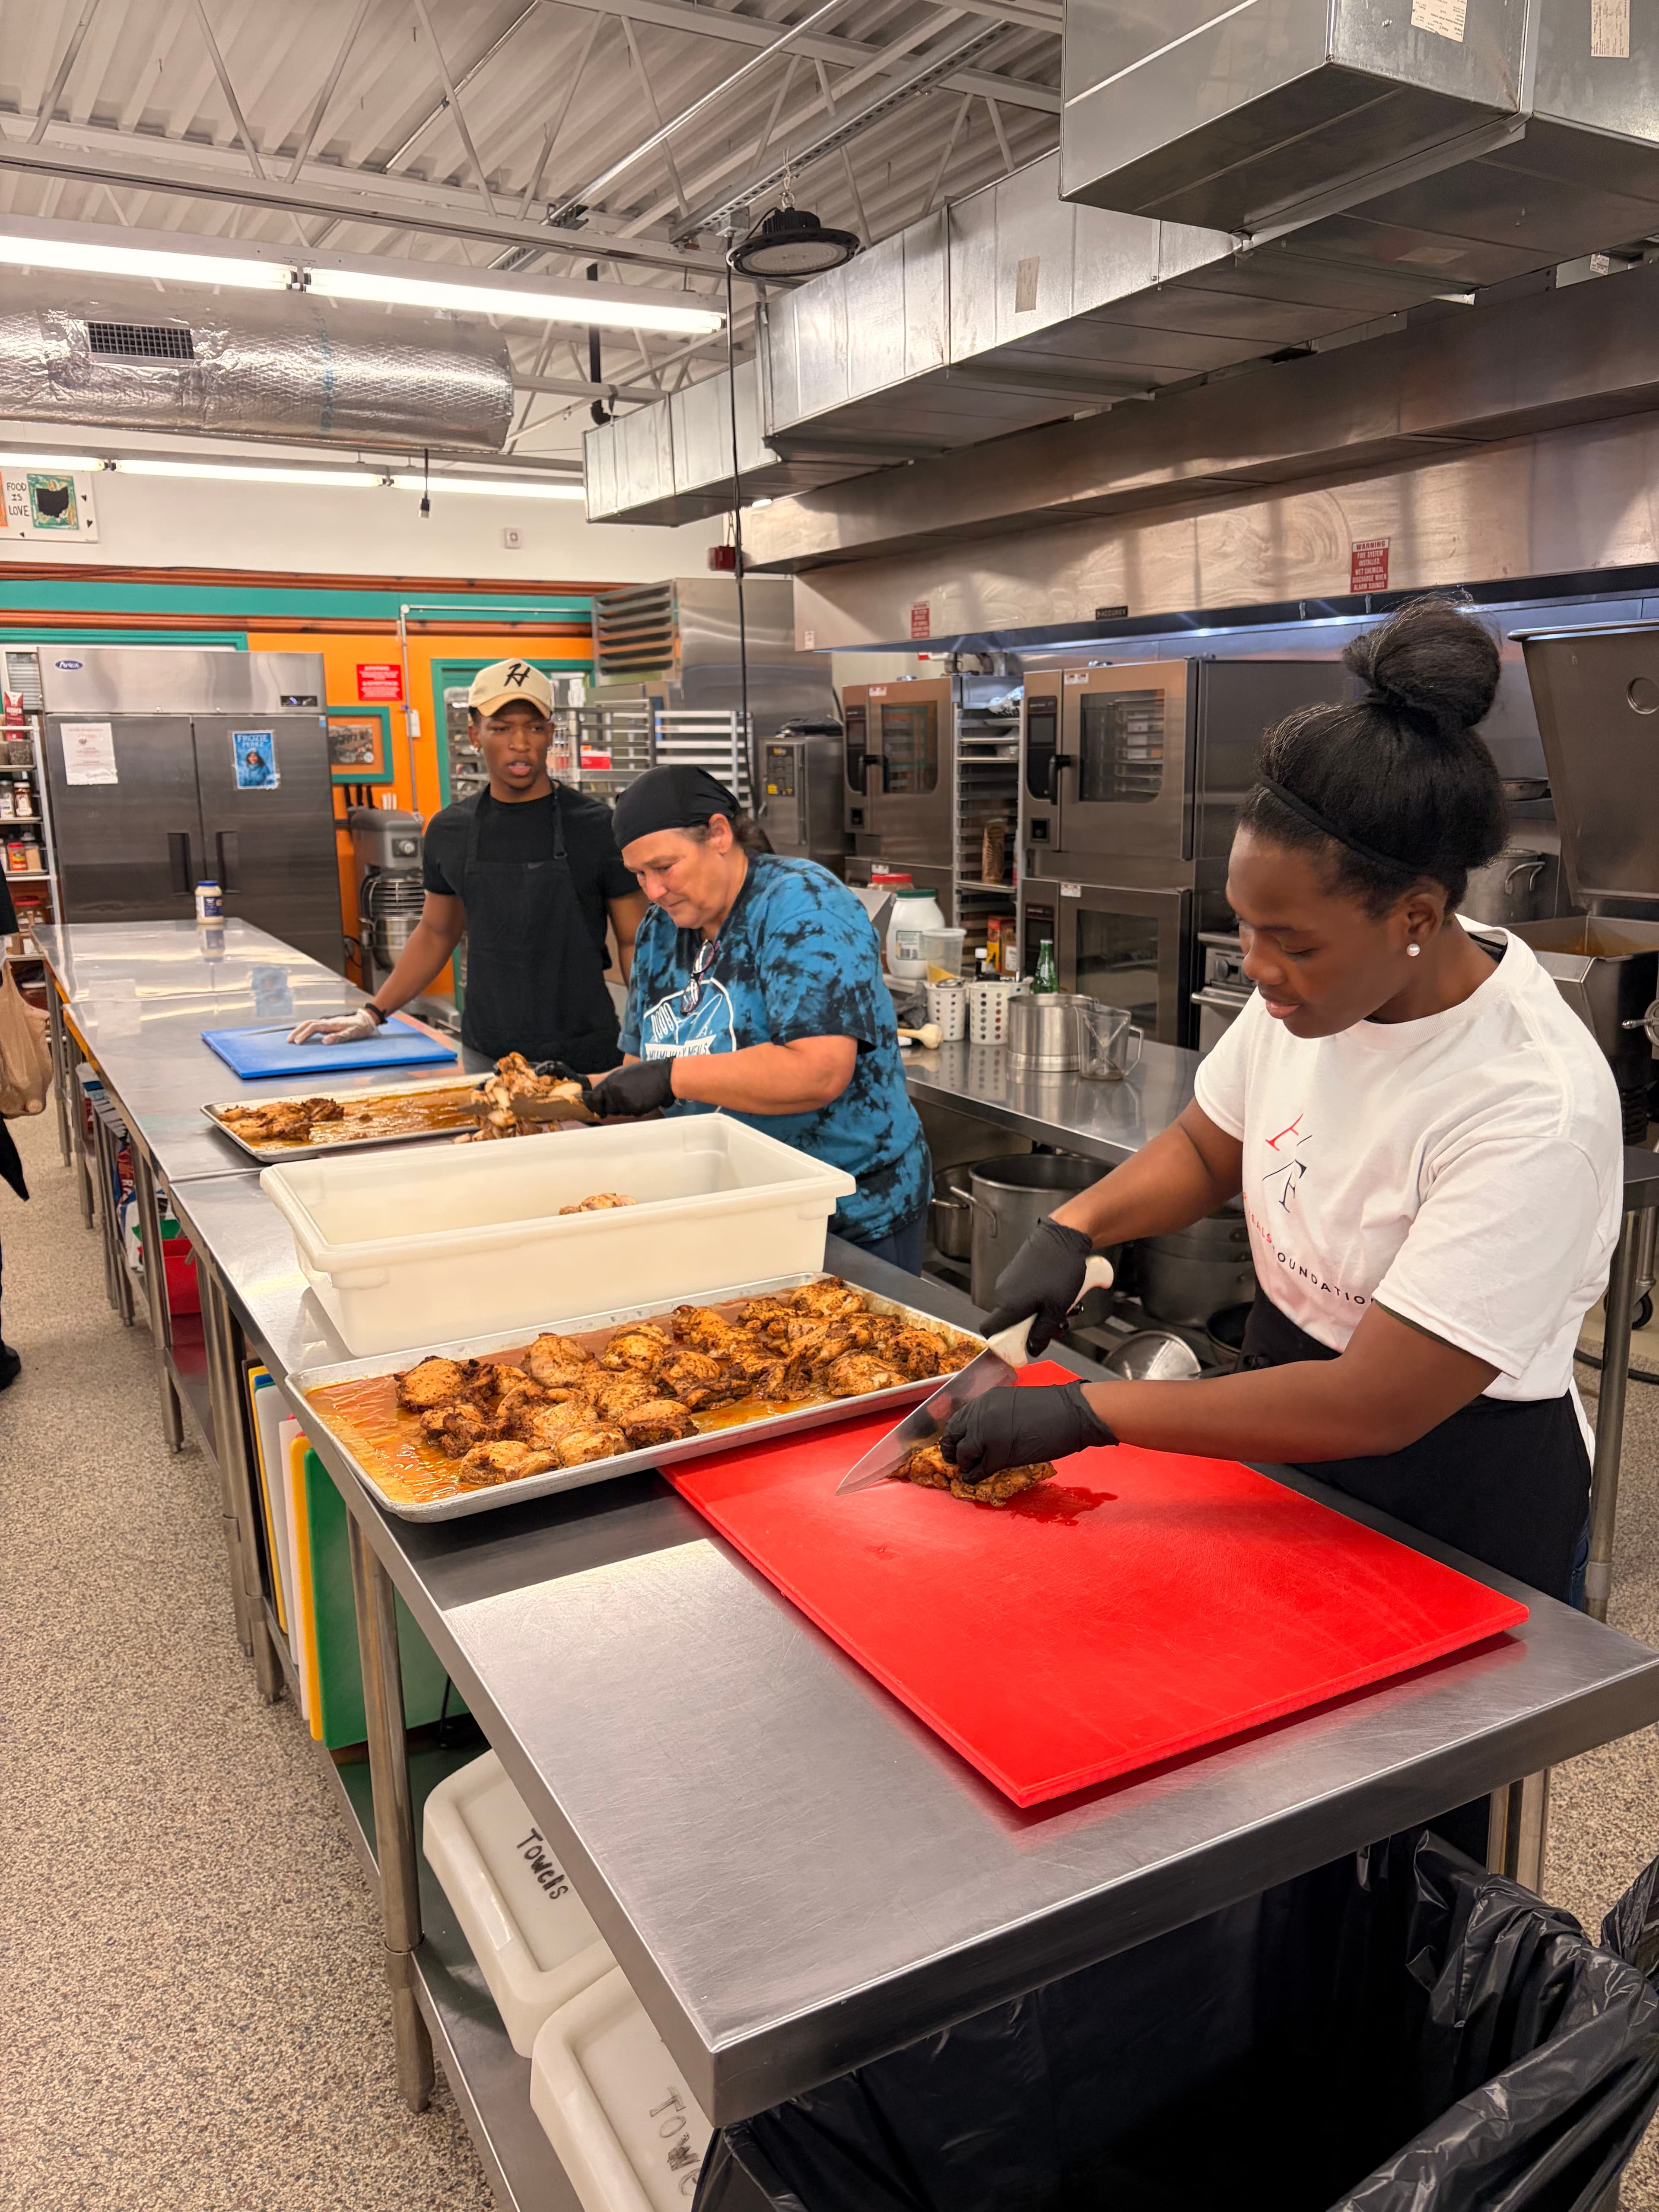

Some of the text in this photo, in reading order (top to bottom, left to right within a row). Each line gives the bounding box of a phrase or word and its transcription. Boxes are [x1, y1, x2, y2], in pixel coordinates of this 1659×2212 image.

[6, 482, 27, 491] FOOD
[8, 505, 29, 516] LOVE
[1357, 540, 1386, 550] WARNING
[1272, 1245, 1374, 1305] OUNDATIO
